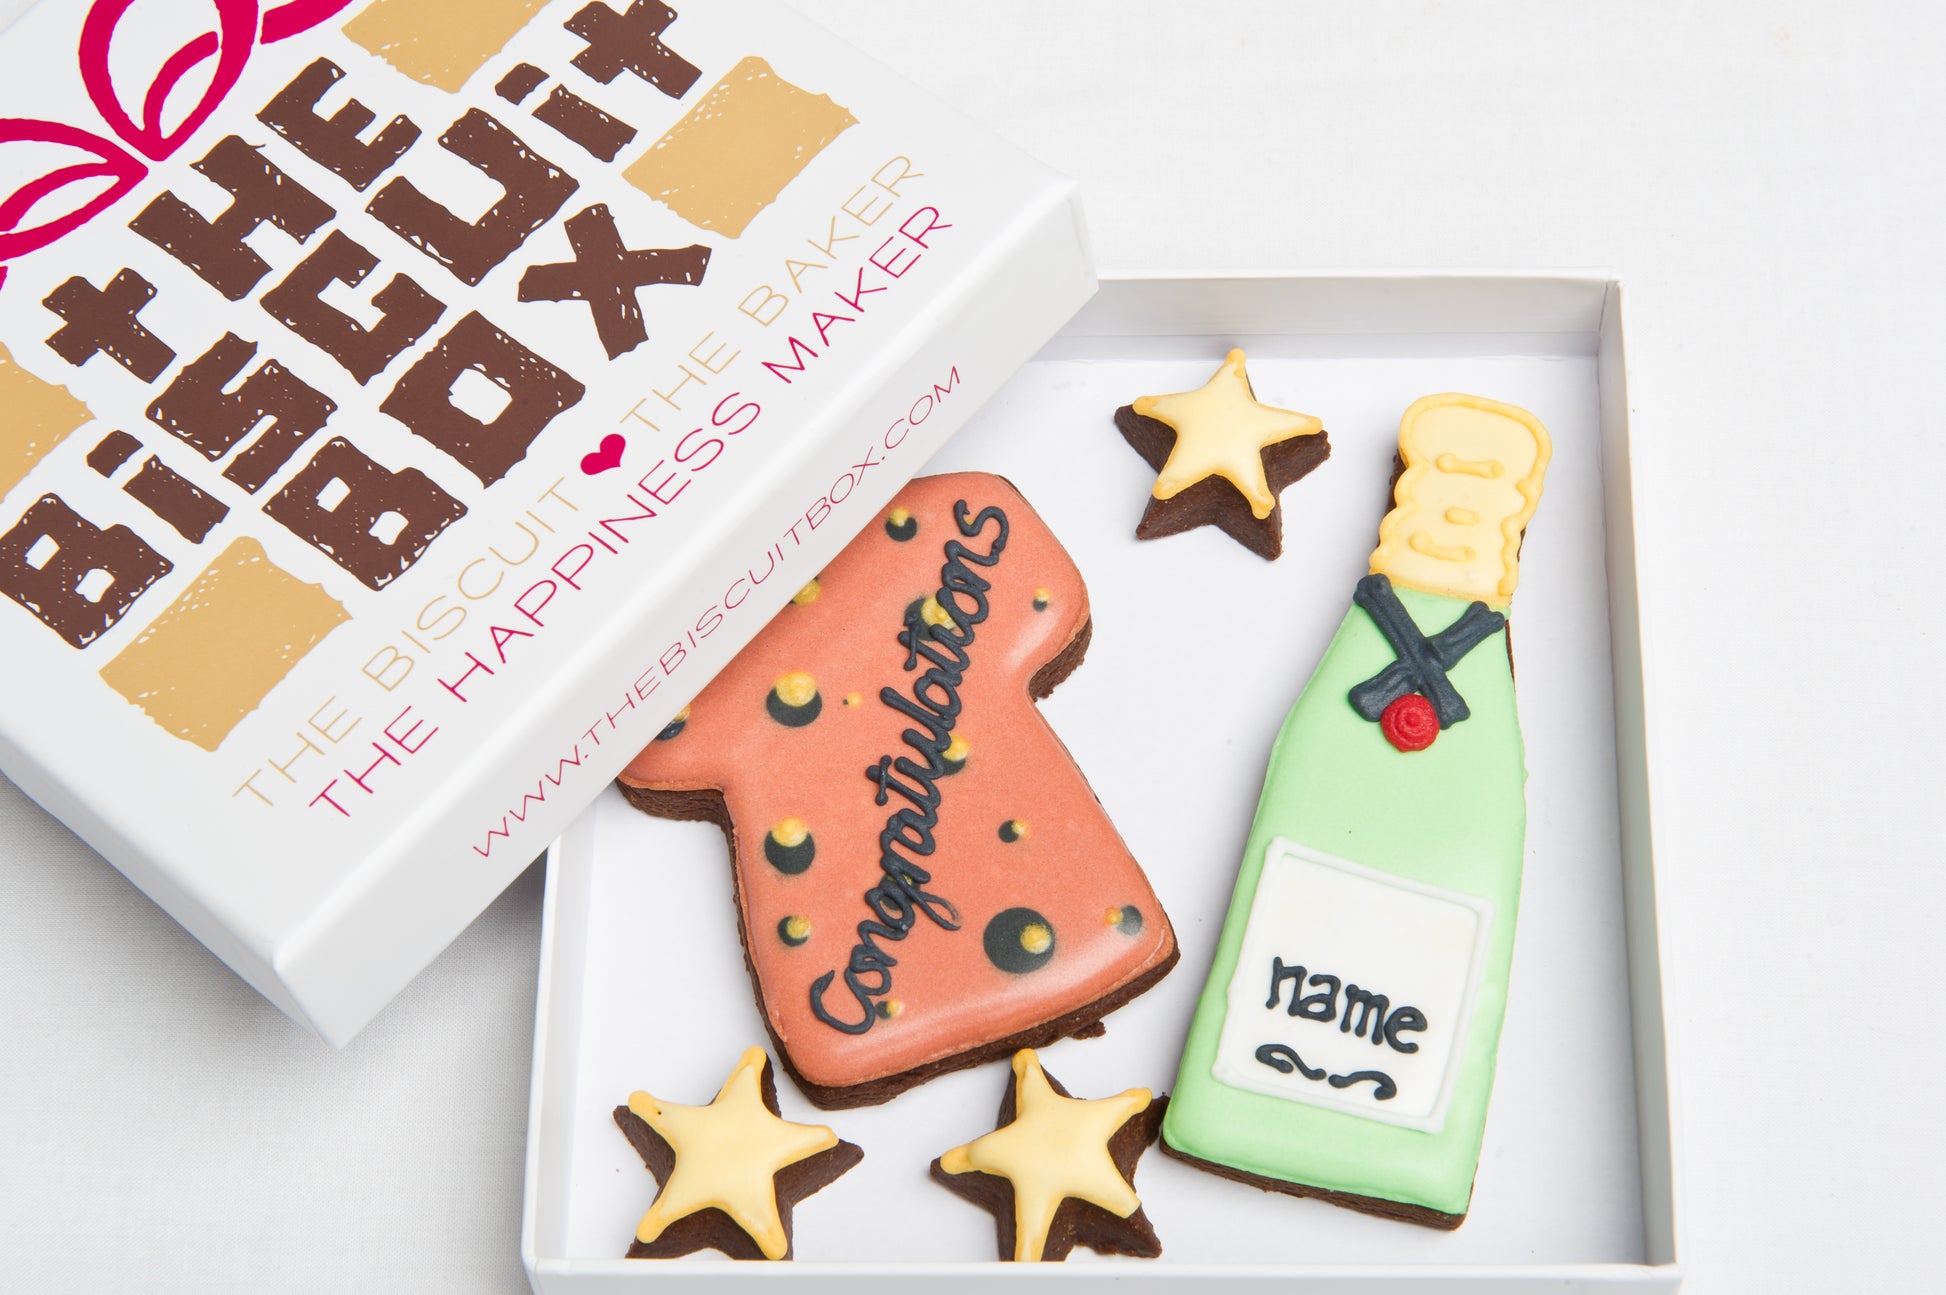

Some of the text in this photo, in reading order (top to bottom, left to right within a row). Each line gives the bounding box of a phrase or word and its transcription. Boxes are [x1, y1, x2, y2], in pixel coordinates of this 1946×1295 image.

[233, 154, 924, 807] THE BISCUIT THE BAKER
[261, 202, 712, 592] BOX
[308, 206, 953, 817] THE HAPPINESS MAKER
[472, 365, 963, 857] WWW.THEBISCUITBOX.COM
[810, 499, 1009, 1035] Congratulations
[1265, 955, 1429, 1055] name
